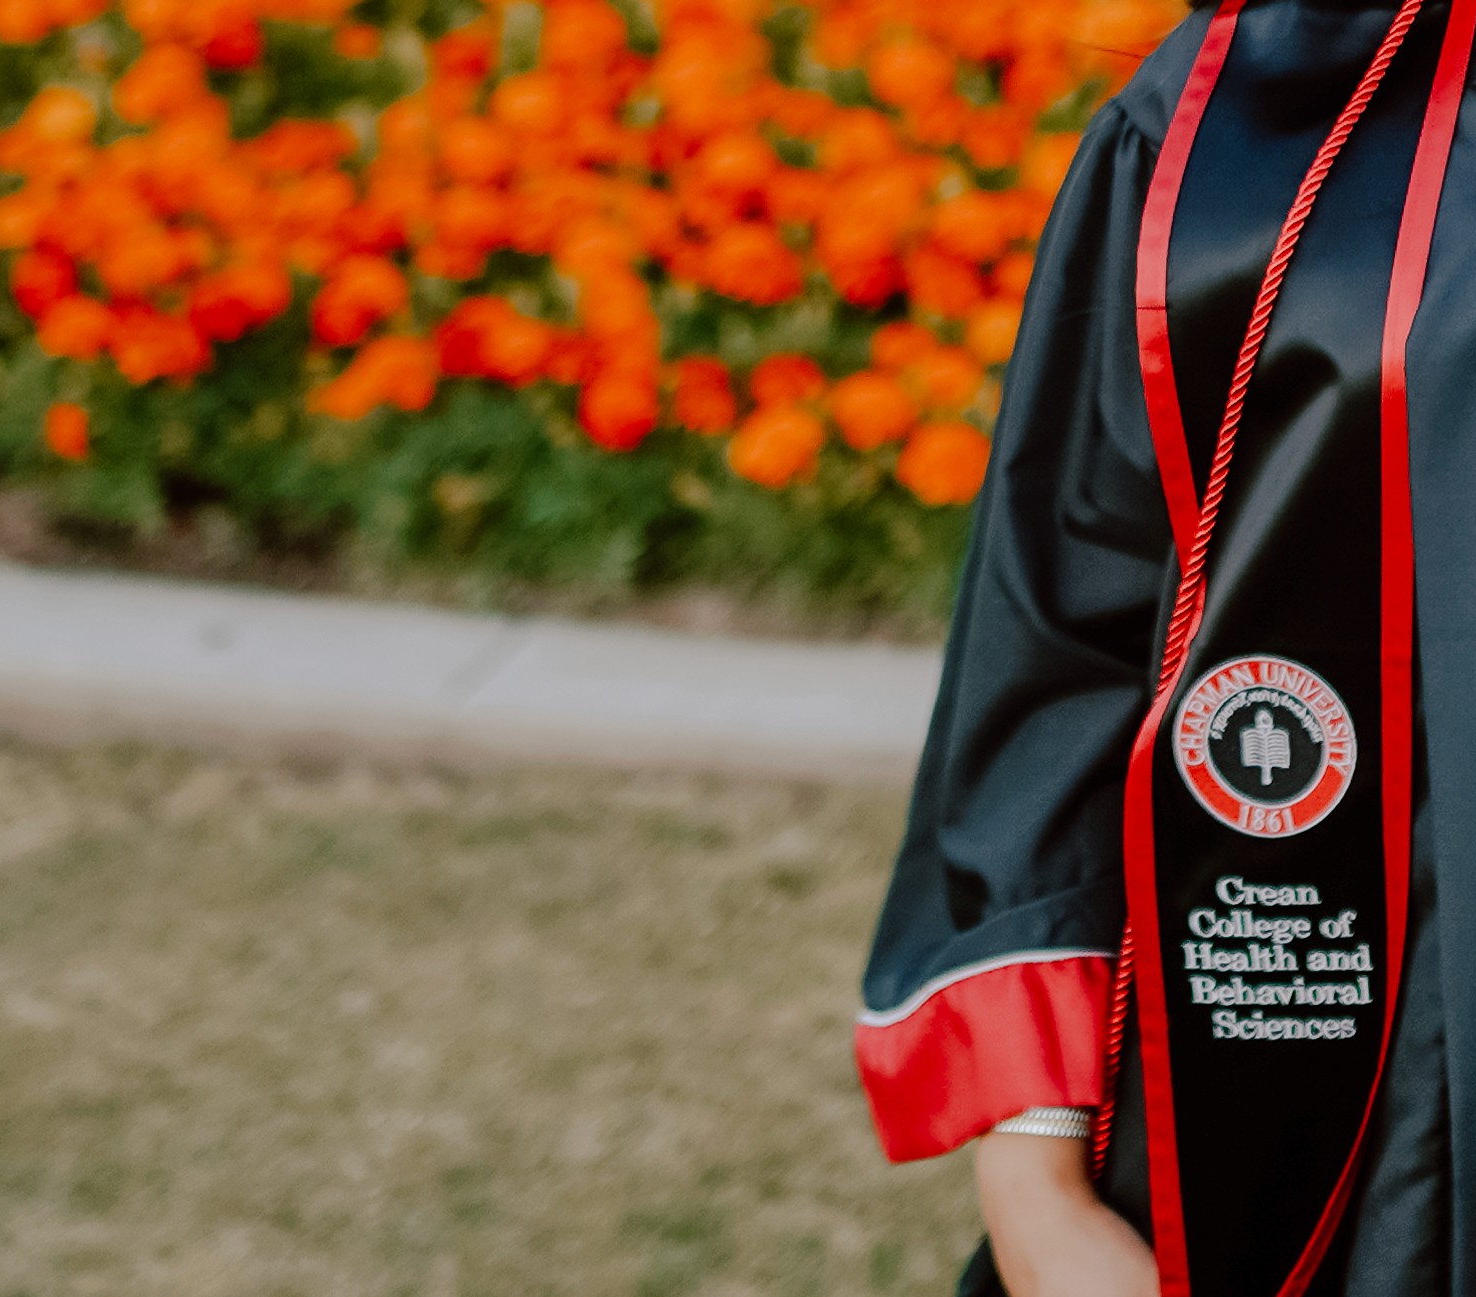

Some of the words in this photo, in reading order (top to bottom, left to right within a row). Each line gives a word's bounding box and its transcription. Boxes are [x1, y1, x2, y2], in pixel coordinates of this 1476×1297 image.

[1180, 662, 1255, 767] CHAPMAN
[1259, 662, 1353, 775] UNIVERSITY
[1239, 804, 1295, 833] 1861
[1215, 875, 1322, 906] Crean
[1188, 909, 1311, 943] College
[1319, 909, 1357, 938] of
[1181, 940, 1298, 972] Health
[1306, 943, 1373, 971] and
[1189, 975, 1374, 1006] Behavioral
[1211, 1009, 1357, 1040] Sciences
